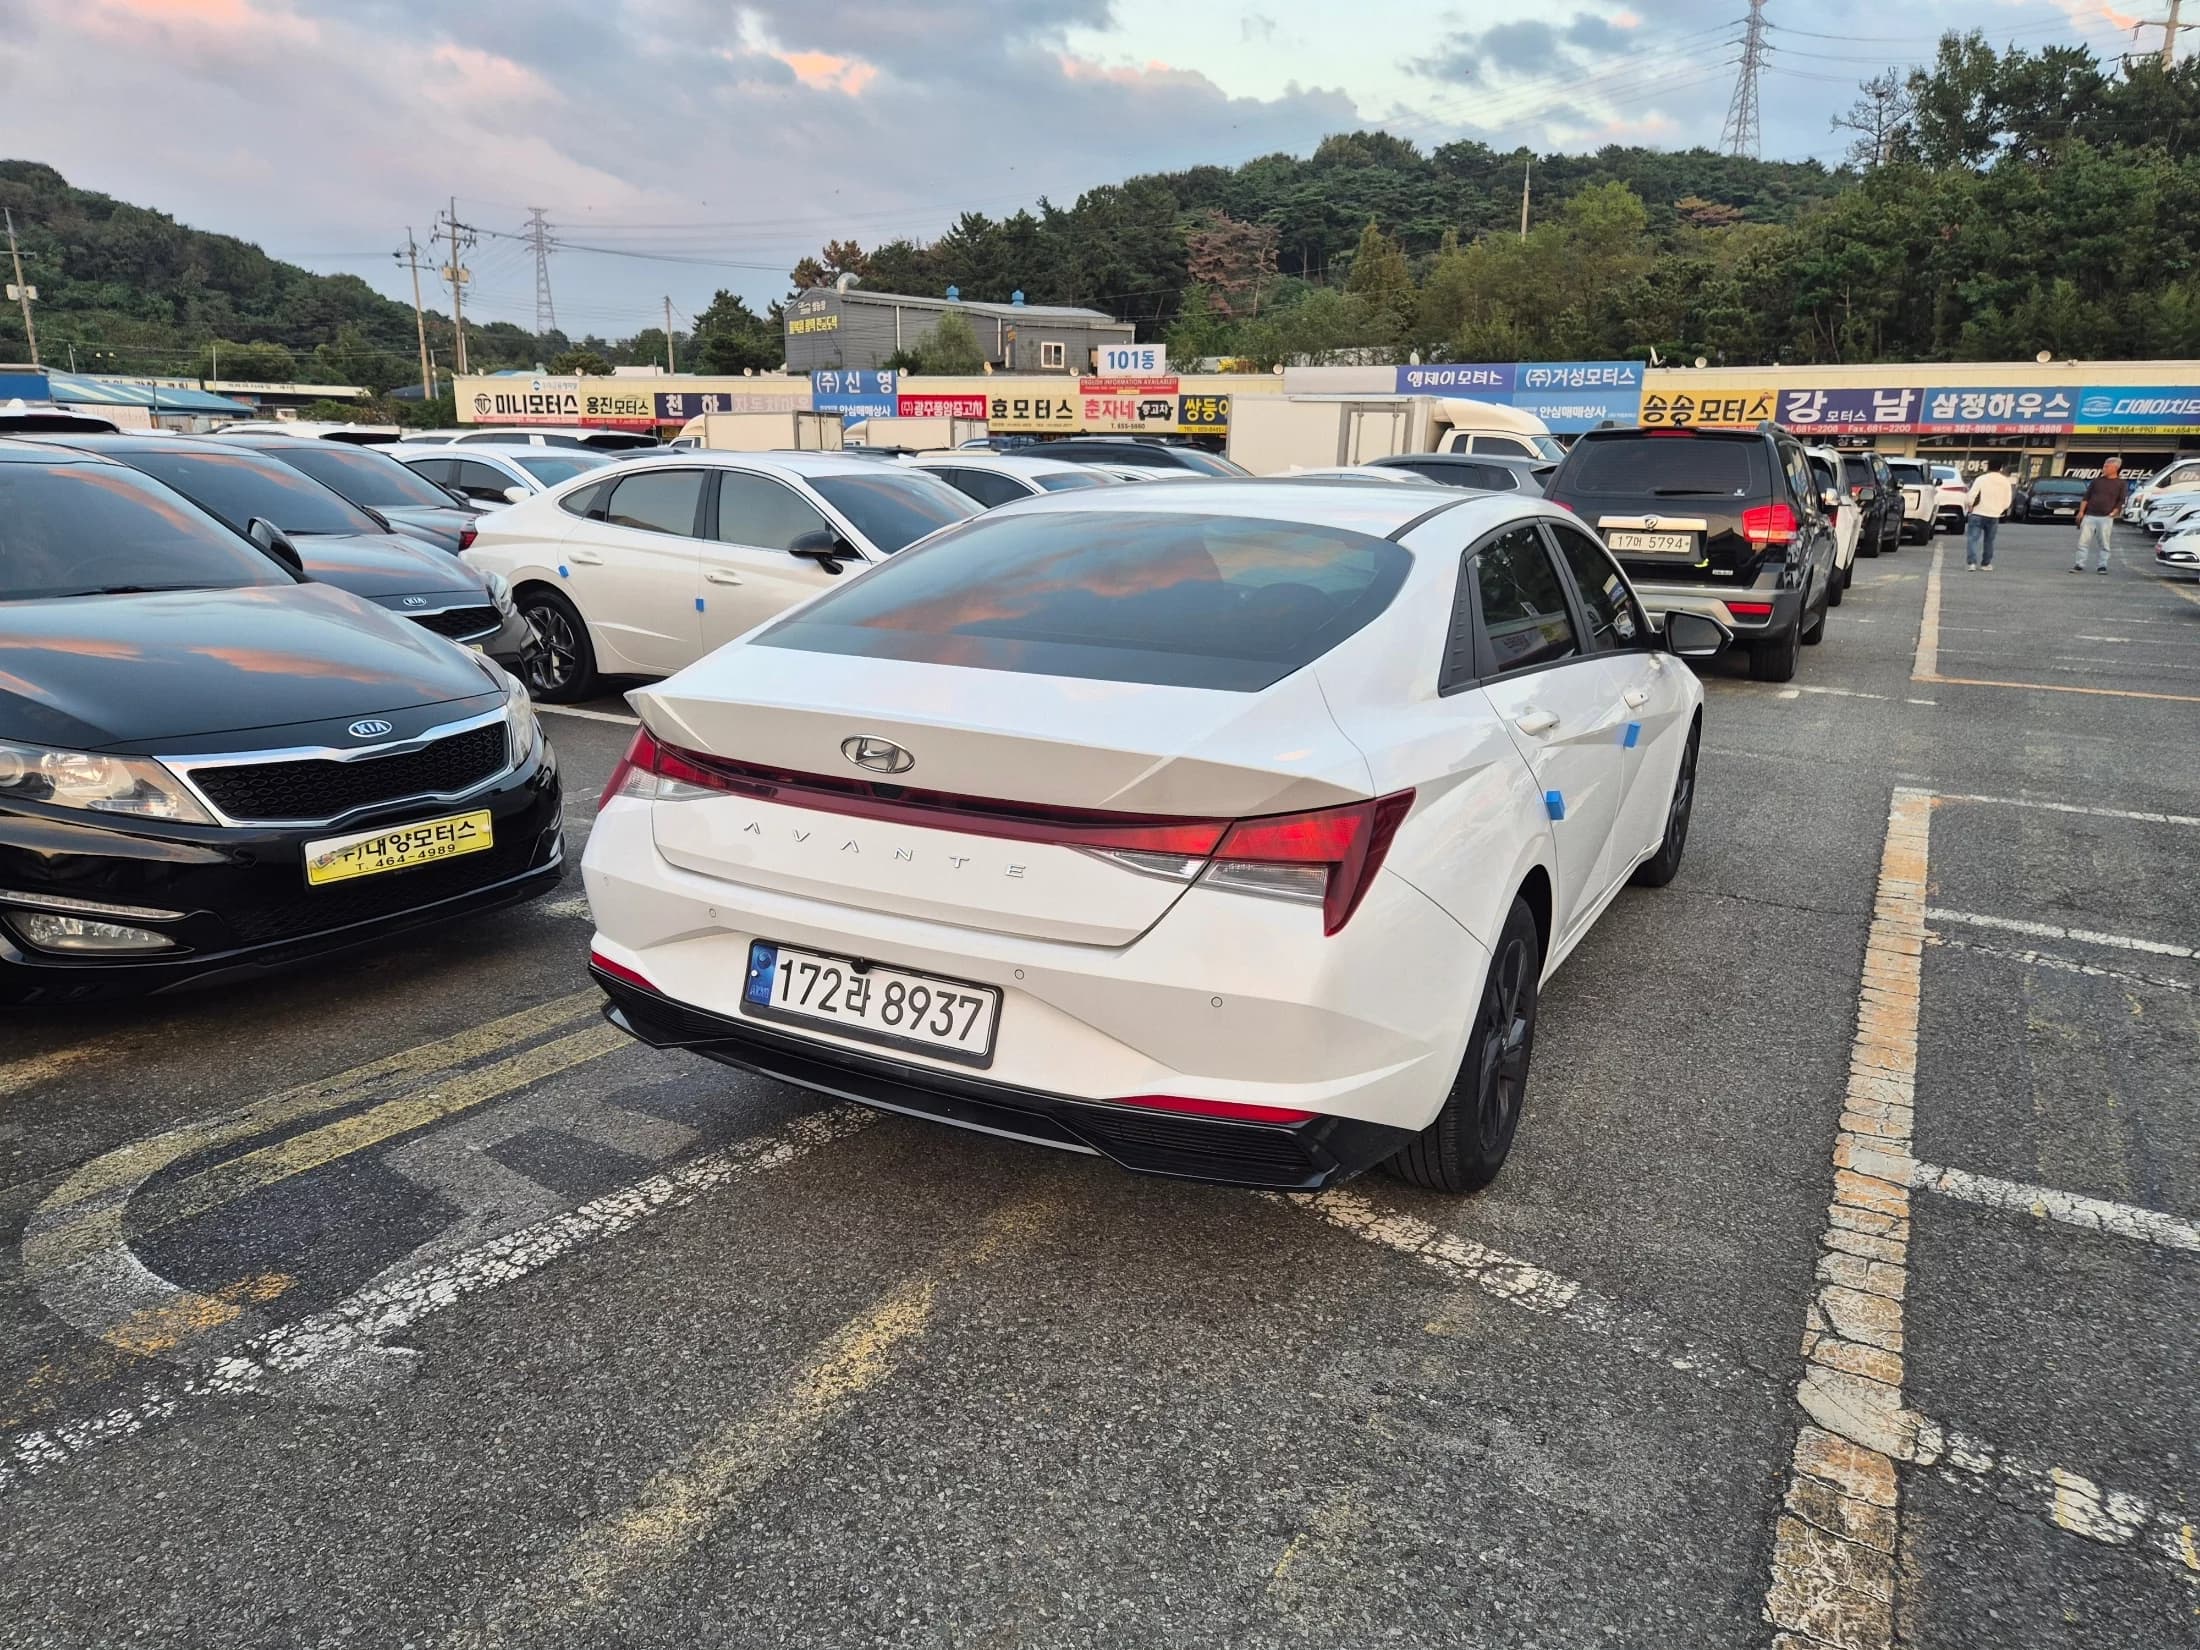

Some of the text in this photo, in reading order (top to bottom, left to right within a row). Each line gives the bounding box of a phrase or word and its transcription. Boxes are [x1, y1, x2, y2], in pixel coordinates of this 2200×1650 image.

[1107, 350, 1155, 369] 101동
[816, 371, 840, 393] (주)
[1104, 378, 1143, 386] INFORMATION
[1525, 368, 1636, 388] (주)거성모터스
[495, 394, 579, 415] 미니모터스
[586, 396, 649, 415] 용진모터스
[991, 398, 1074, 420] 효모터스
[1084, 398, 1169, 420] 춘자네 중고차
[1539, 405, 1607, 418] 안심매매상사
[1643, 394, 1769, 423] 송송모터스
[1785, 389, 1916, 423] 강 모터스 남
[1931, 393, 2071, 420] 삼정하우스
[1617, 535, 1683, 549] 17머 5794
[355, 843, 457, 872] T. 464-4989
[743, 821, 1026, 879] AVANTE
[779, 958, 984, 1041] 172라 8937
